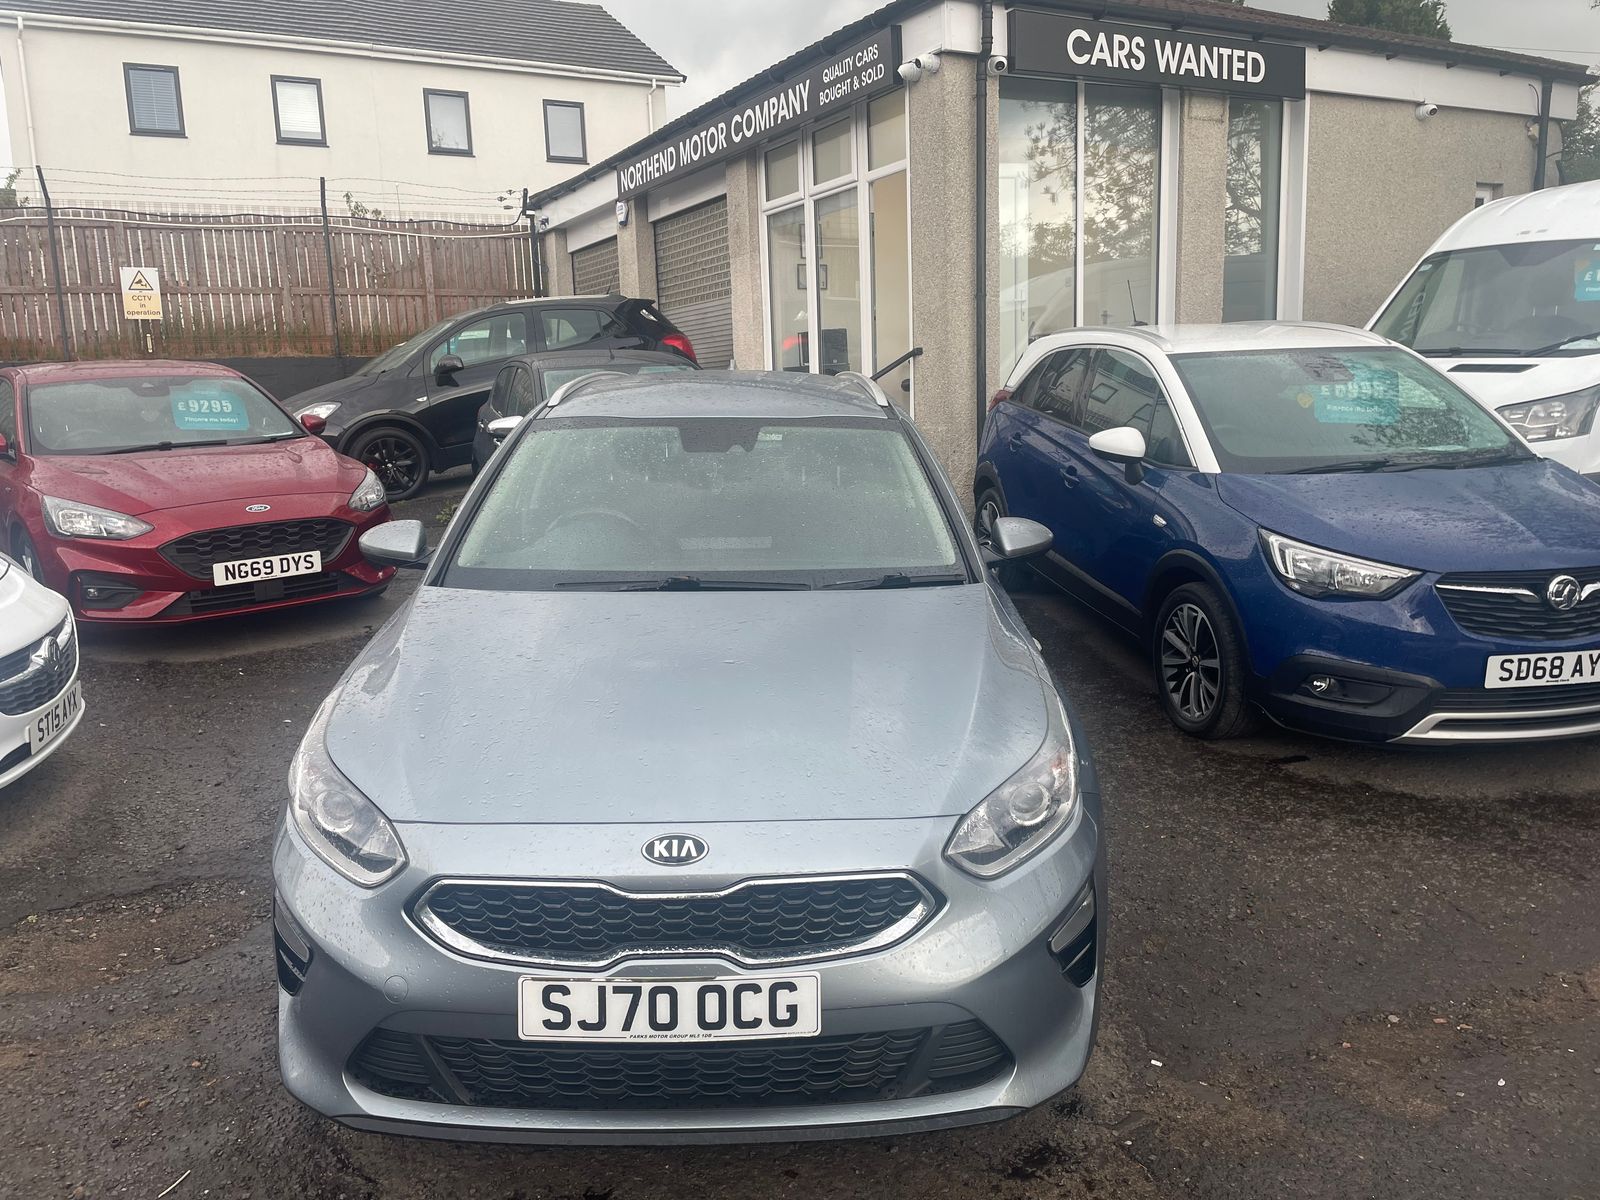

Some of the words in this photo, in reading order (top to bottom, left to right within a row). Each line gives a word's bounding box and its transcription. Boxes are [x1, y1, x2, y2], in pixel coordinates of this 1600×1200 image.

[822, 55, 854, 84] QUALITY
[855, 43, 879, 65] CARS
[1066, 28, 1146, 71] CARS
[1154, 38, 1266, 84] WANTED
[819, 81, 852, 106] BOUGHT
[853, 74, 860, 91] &
[861, 63, 885, 86] SOLD
[620, 147, 676, 193] NORTHEND
[679, 122, 728, 168] MOTOR
[730, 79, 811, 143] COMPANY
[224, 560, 274, 581] NG69
[279, 554, 314, 574] DYS
[1498, 655, 1564, 681] SD68
[37, 704, 61, 742] ST15
[62, 687, 78, 722] AYX
[653, 839, 698, 858] KIA
[541, 984, 678, 1032] SJ70
[697, 981, 798, 1031] OCG
